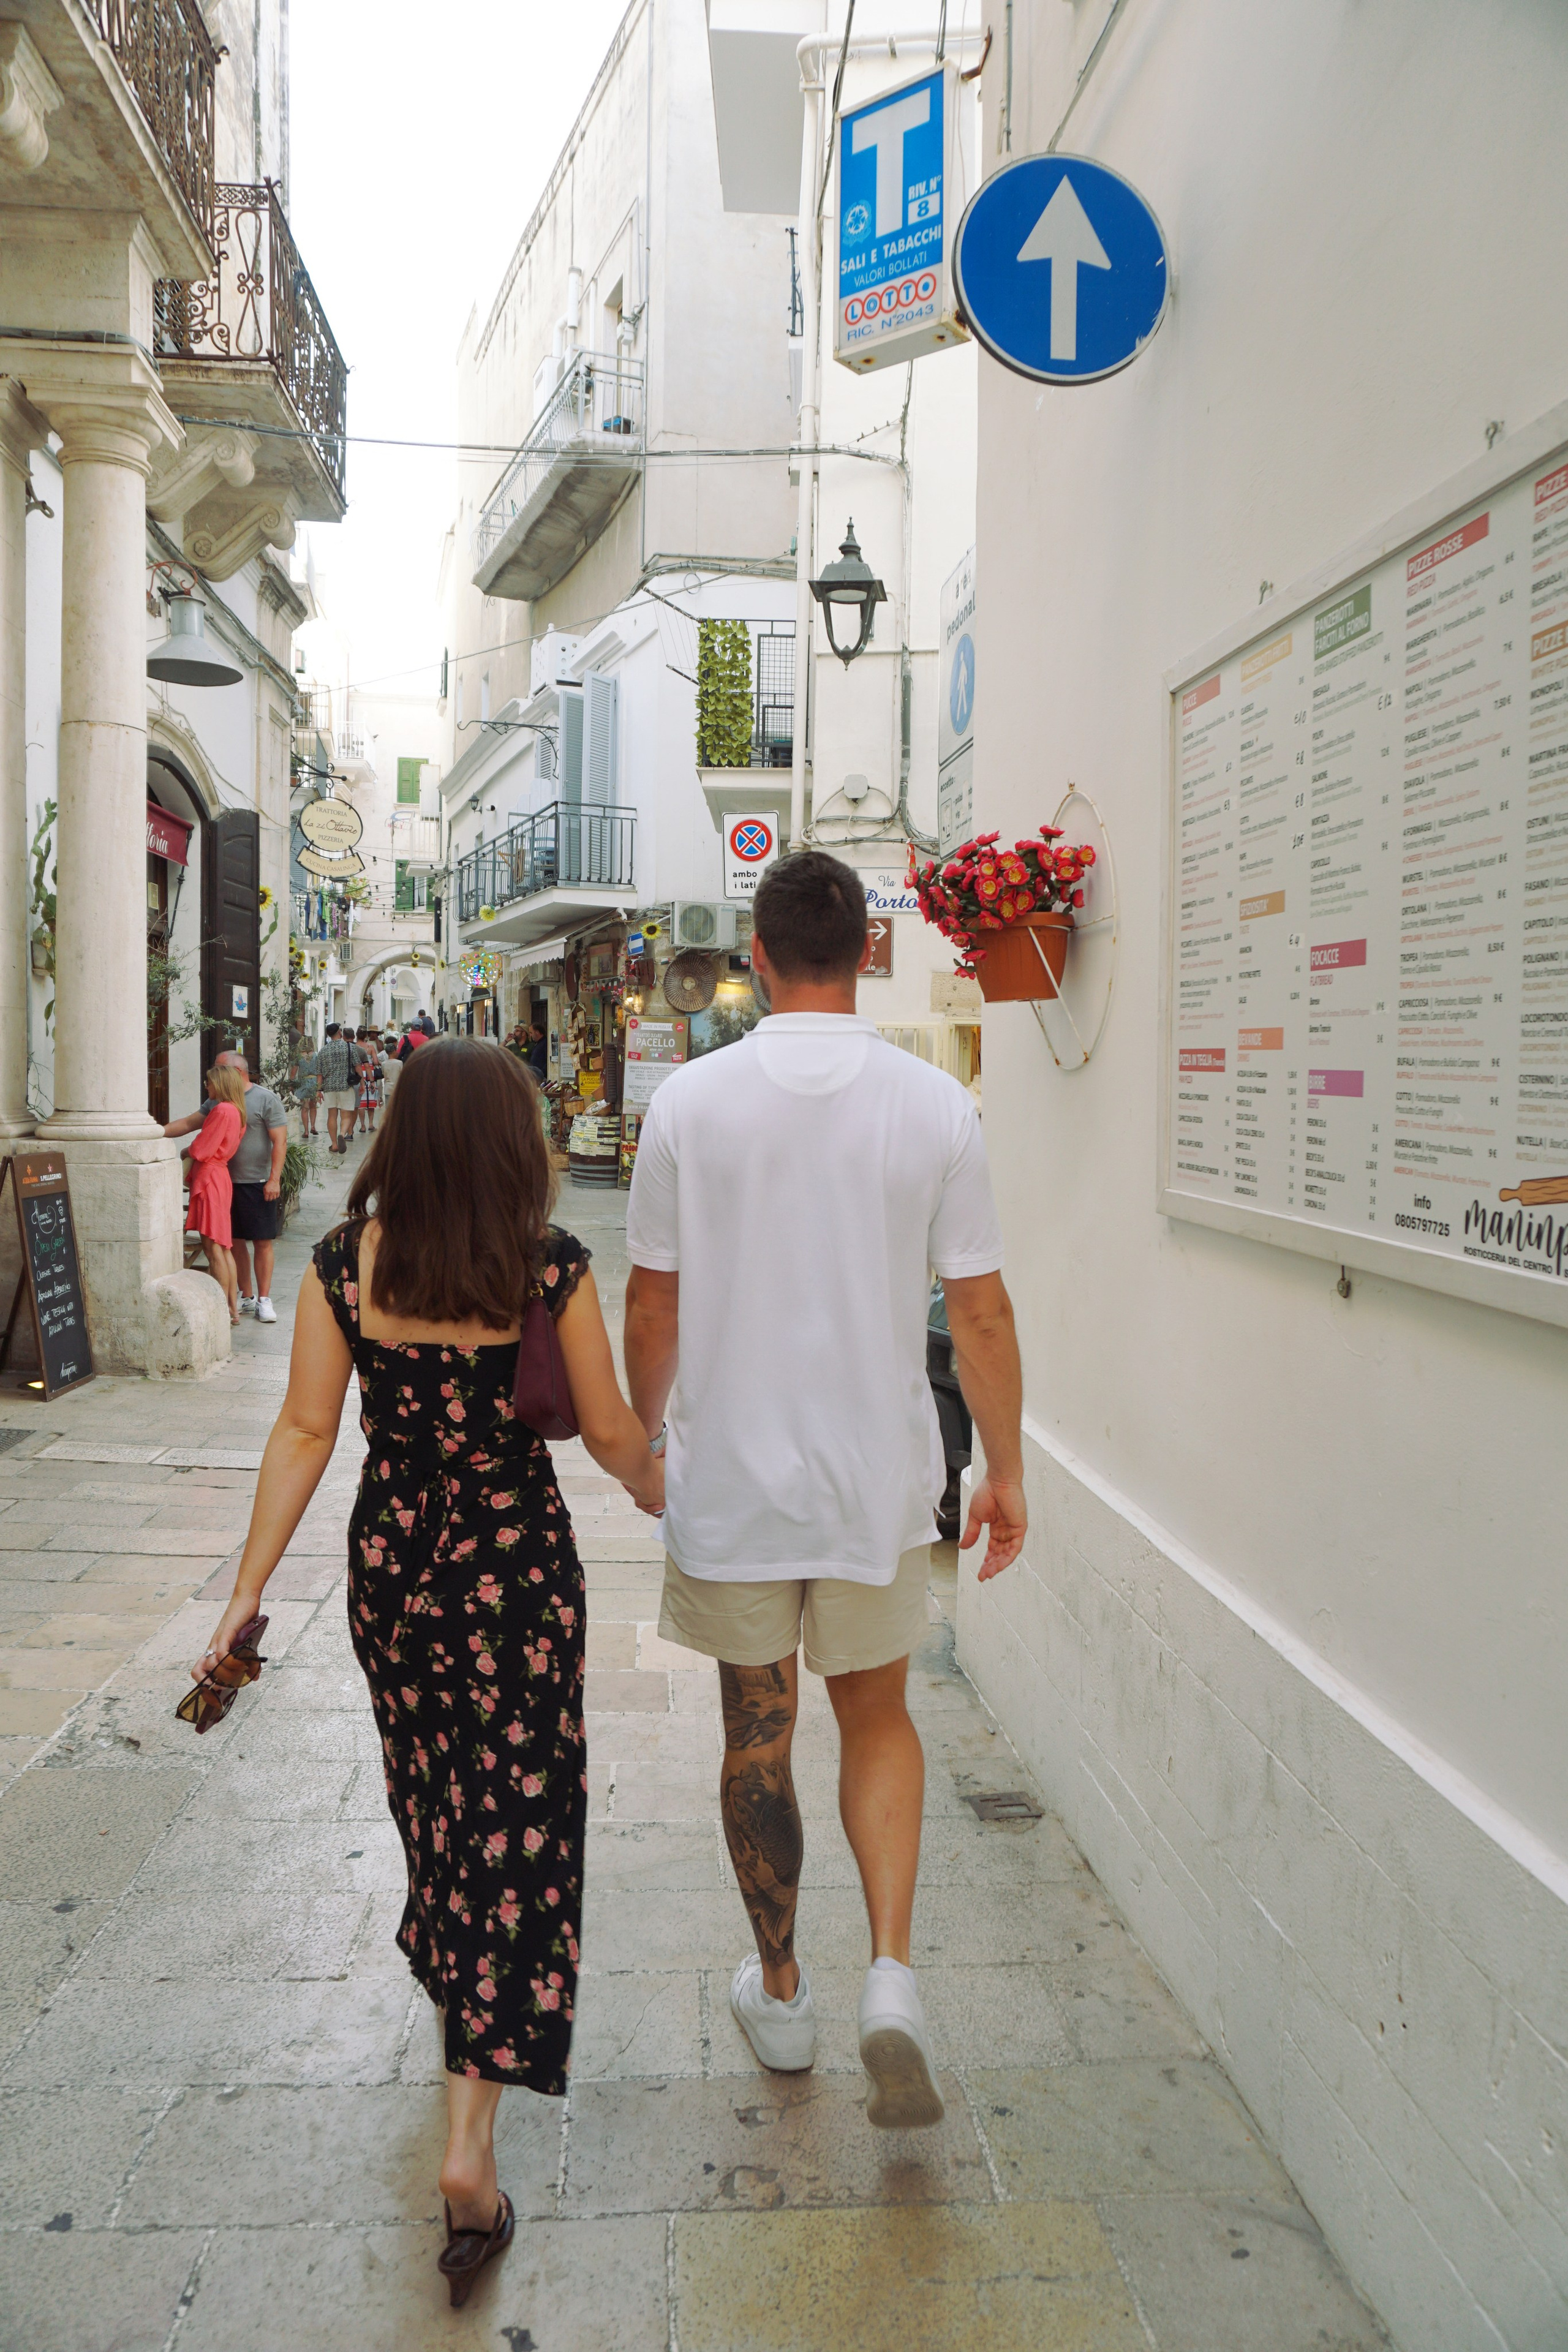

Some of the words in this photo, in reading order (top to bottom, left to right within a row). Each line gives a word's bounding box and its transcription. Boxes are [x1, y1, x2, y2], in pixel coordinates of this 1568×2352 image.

[852, 87, 930, 238] T
[908, 182, 927, 201] RIV.
[917, 200, 929, 217] 8
[841, 253, 865, 275] SALI
[871, 248, 877, 263] E
[883, 224, 941, 258] TABACCHI
[854, 265, 885, 287] VALORI
[889, 251, 927, 275] BOLLATI
[847, 274, 935, 323] LOTTO
[848, 324, 873, 341] RIC.
[1409, 550, 1432, 578] PIZZE
[1433, 532, 1463, 564] ROSSE
[1407, 581, 1418, 598] RED
[1419, 571, 1436, 592] PIZZA
[947, 590, 976, 645] pedonal
[1406, 628, 1437, 651] MARGHERITA
[1405, 680, 1423, 696] NAPOLI
[1183, 692, 1196, 712] PUCCE
[1404, 727, 1427, 745] PUGLIESE
[315, 806, 347, 817] TRATTORIA
[326, 820, 357, 834] Ottavio
[318, 834, 344, 843] PIZZERIA
[306, 858, 326, 870] CUCINA
[326, 863, 356, 872] CASALINGA
[878, 875, 896, 887] Via
[1402, 870, 1423, 884] WURSTEL
[1524, 878, 1549, 892] FASANO
[1401, 903, 1427, 916] ORTOLANA
[1523, 916, 1554, 930] CAPITOLO
[1311, 948, 1339, 966] FOCACCE
[1400, 952, 1418, 962] TROPEA
[1523, 951, 1559, 964] POLIGNANO
[1310, 973, 1333, 986] FLATBREAD
[1398, 997, 1428, 1008] CAPRICCIOSA
[636, 1038, 675, 1047] PACELLO
[1396, 1057, 1415, 1066] BUFALA
[1309, 1074, 1325, 1090] BIRRE
[1518, 1074, 1555, 1085] CISTERNINO
[1395, 1091, 1411, 1101] COTTO
[1395, 1138, 1422, 1150] AMERICANA
[1516, 1135, 1543, 1147] NUTELLA
[40, 1173, 61, 1182] S.PELLEGRINO
[1414, 1194, 1431, 1210] info
[1395, 1213, 1450, 1237] 0805797725
[1464, 1246, 1507, 1264] ROSTICCERIA
[1508, 1256, 1521, 1267] DEL
[1523, 1259, 1553, 1274] CENTRO
